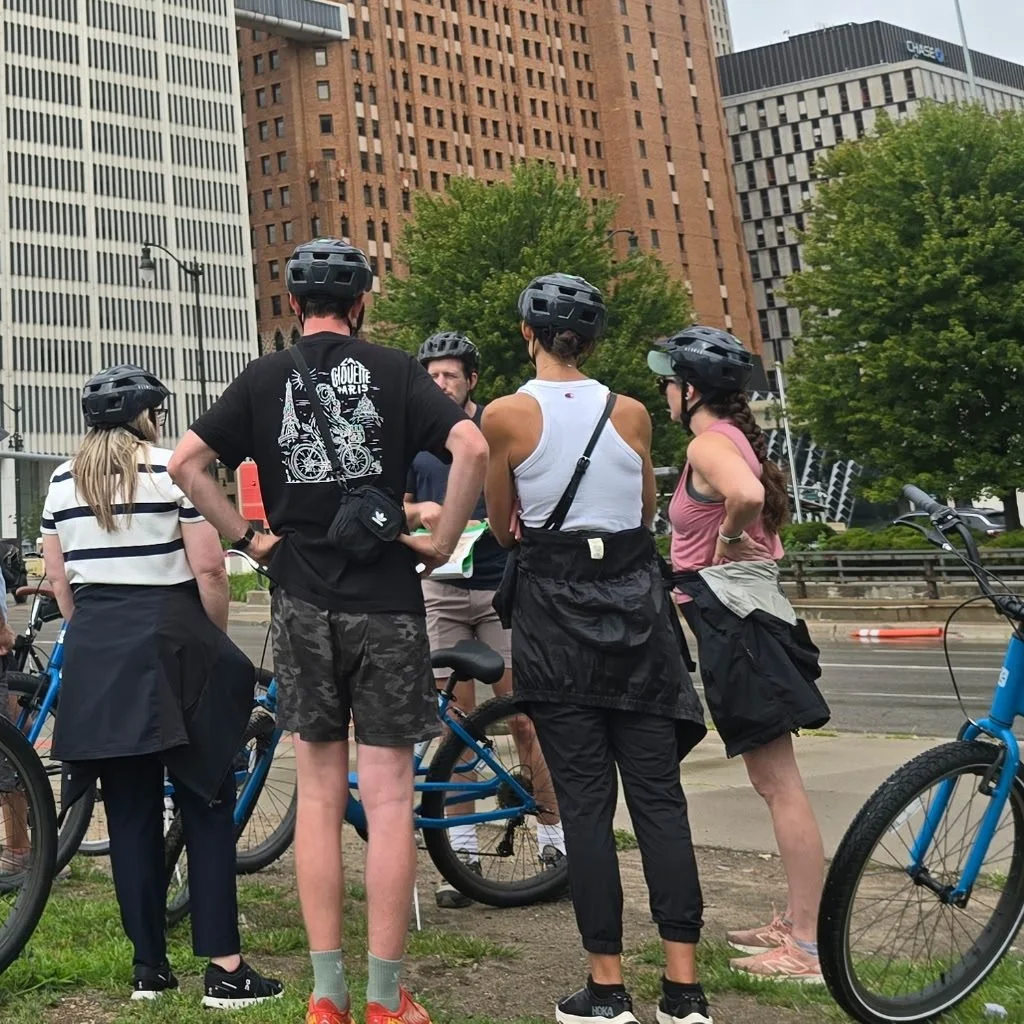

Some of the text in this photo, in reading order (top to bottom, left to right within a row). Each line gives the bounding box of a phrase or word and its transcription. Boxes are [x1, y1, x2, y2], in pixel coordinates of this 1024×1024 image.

[906, 40, 936, 59] CHASE
[337, 384, 369, 395] PARIS
[591, 1005, 614, 1017] HOKA
